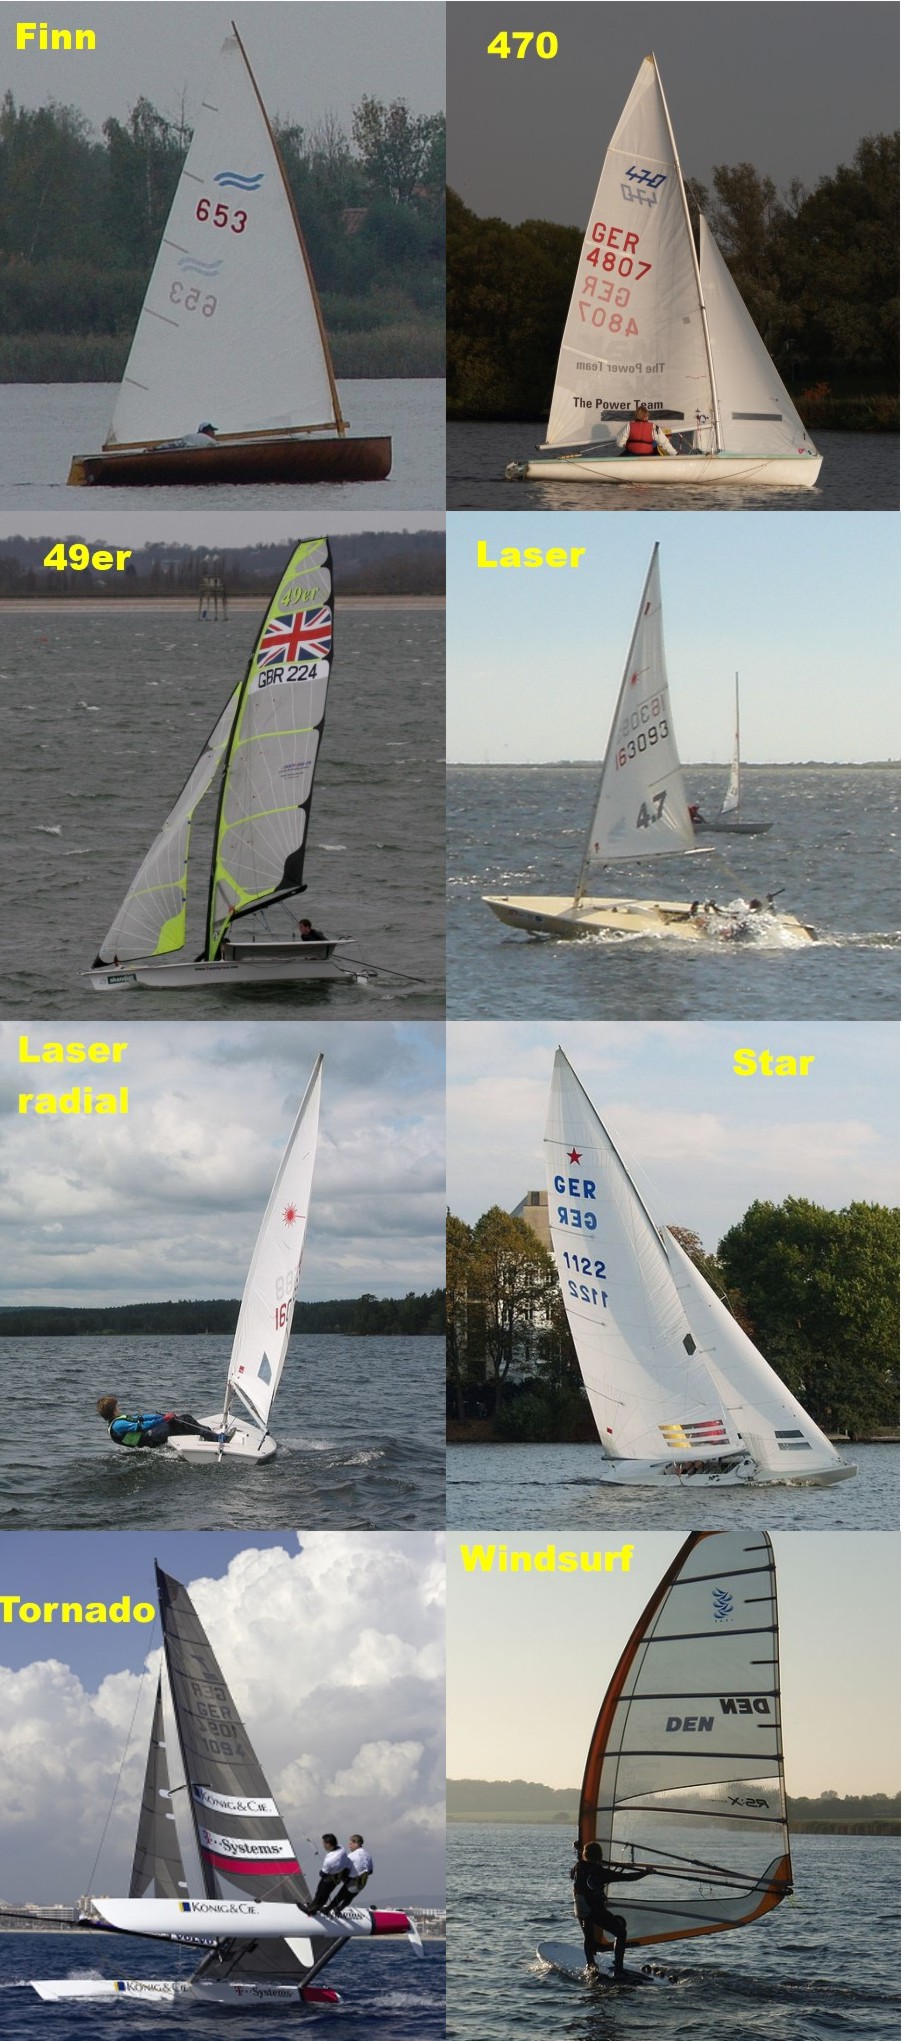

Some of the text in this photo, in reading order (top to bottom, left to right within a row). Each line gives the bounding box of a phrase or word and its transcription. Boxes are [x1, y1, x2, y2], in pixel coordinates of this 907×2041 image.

[625, 166, 667, 189] 470
[196, 198, 248, 233] 653
[591, 222, 640, 255] GER
[586, 247, 652, 281] 4807
[573, 397, 664, 410] The Power Team
[281, 586, 320, 607] 49er
[258, 663, 317, 689] GBR 224
[616, 720, 669, 770] 163093
[636, 790, 667, 829] 4.7
[554, 1175, 596, 1199] GER
[563, 1251, 606, 1279] 1122
[196, 1702, 233, 1720] GER
[666, 1716, 714, 1732] DEN
